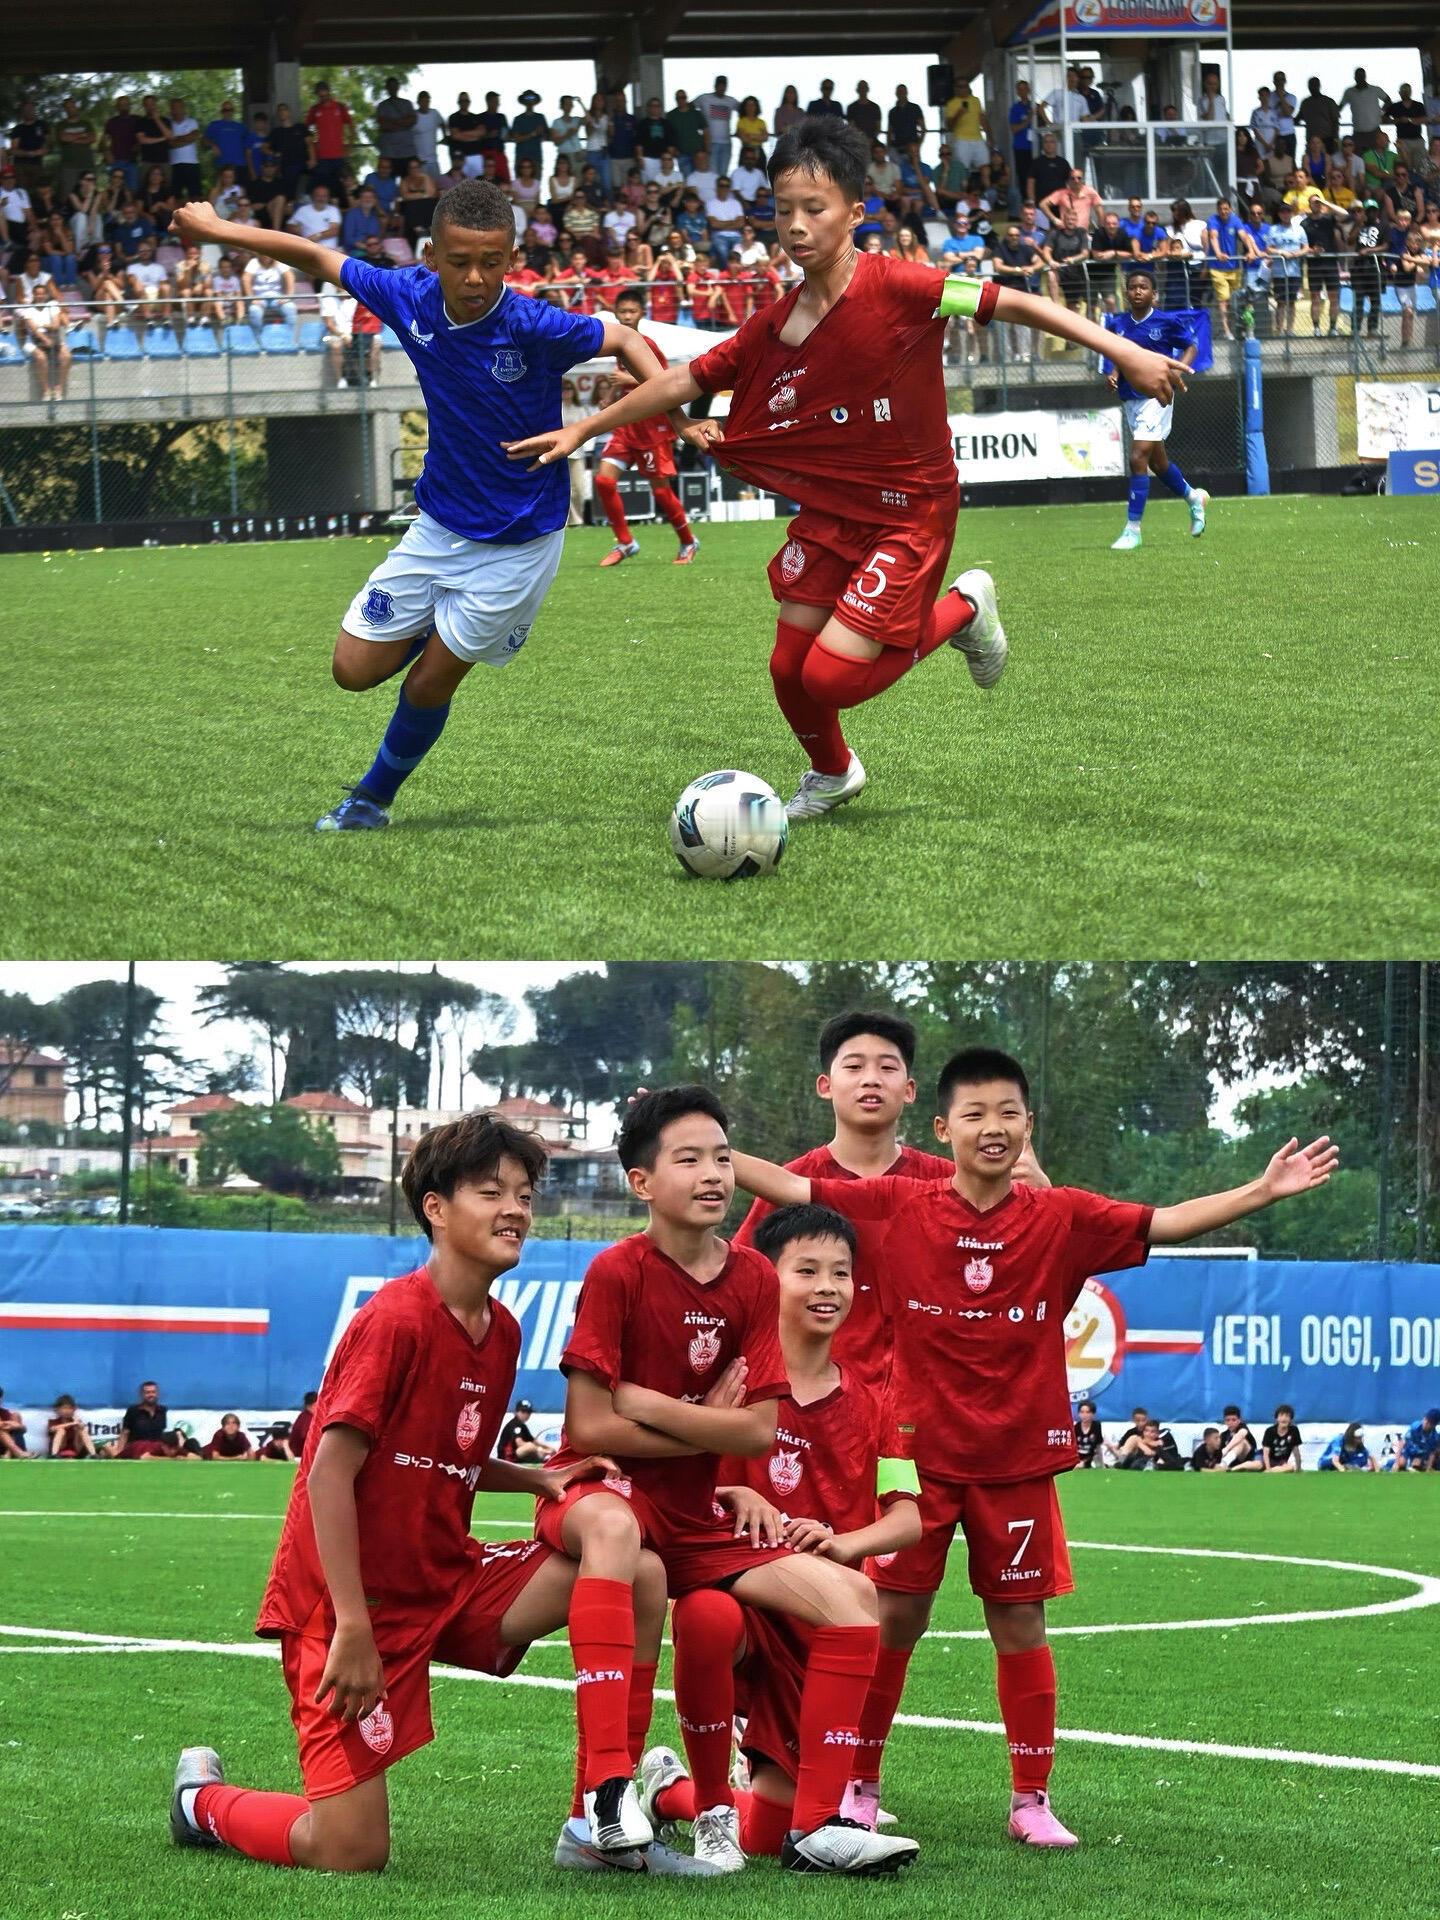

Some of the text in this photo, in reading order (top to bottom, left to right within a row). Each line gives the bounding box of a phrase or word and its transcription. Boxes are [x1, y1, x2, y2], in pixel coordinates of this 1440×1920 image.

[643, 452, 656, 469] 2
[1413, 461, 1440, 488] S
[857, 551, 896, 598] 5
[1213, 1315, 1440, 1372] IERI, OGGI, DO
[776, 1432, 812, 1450] THLETA
[1008, 1519, 1035, 1566] 7
[1000, 1570, 1042, 1582] ATHLETA
